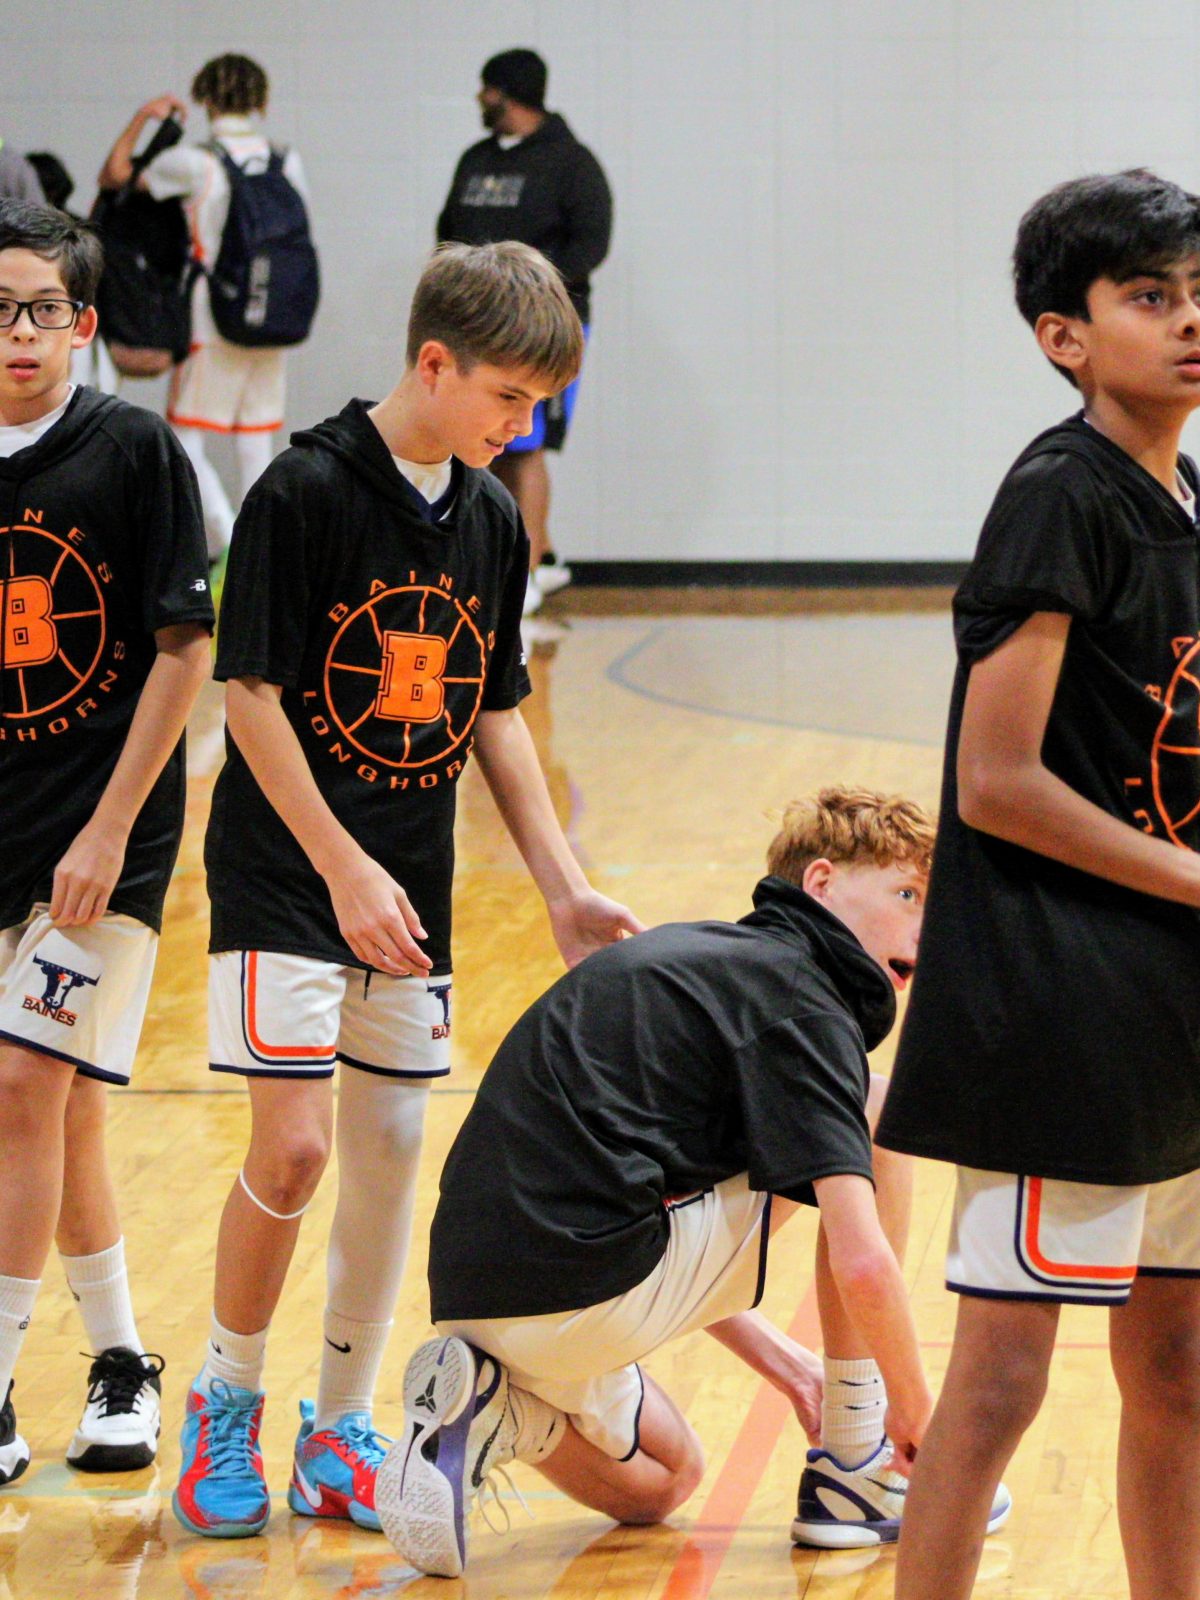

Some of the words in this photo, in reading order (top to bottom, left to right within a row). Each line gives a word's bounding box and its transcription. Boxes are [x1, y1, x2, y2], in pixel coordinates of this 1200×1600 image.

[24, 508, 113, 584] NES
[0, 640, 125, 742] HORNS
[375, 630, 448, 724] B
[303, 690, 474, 790] LONGHOR
[22, 996, 78, 1028] BAINES
